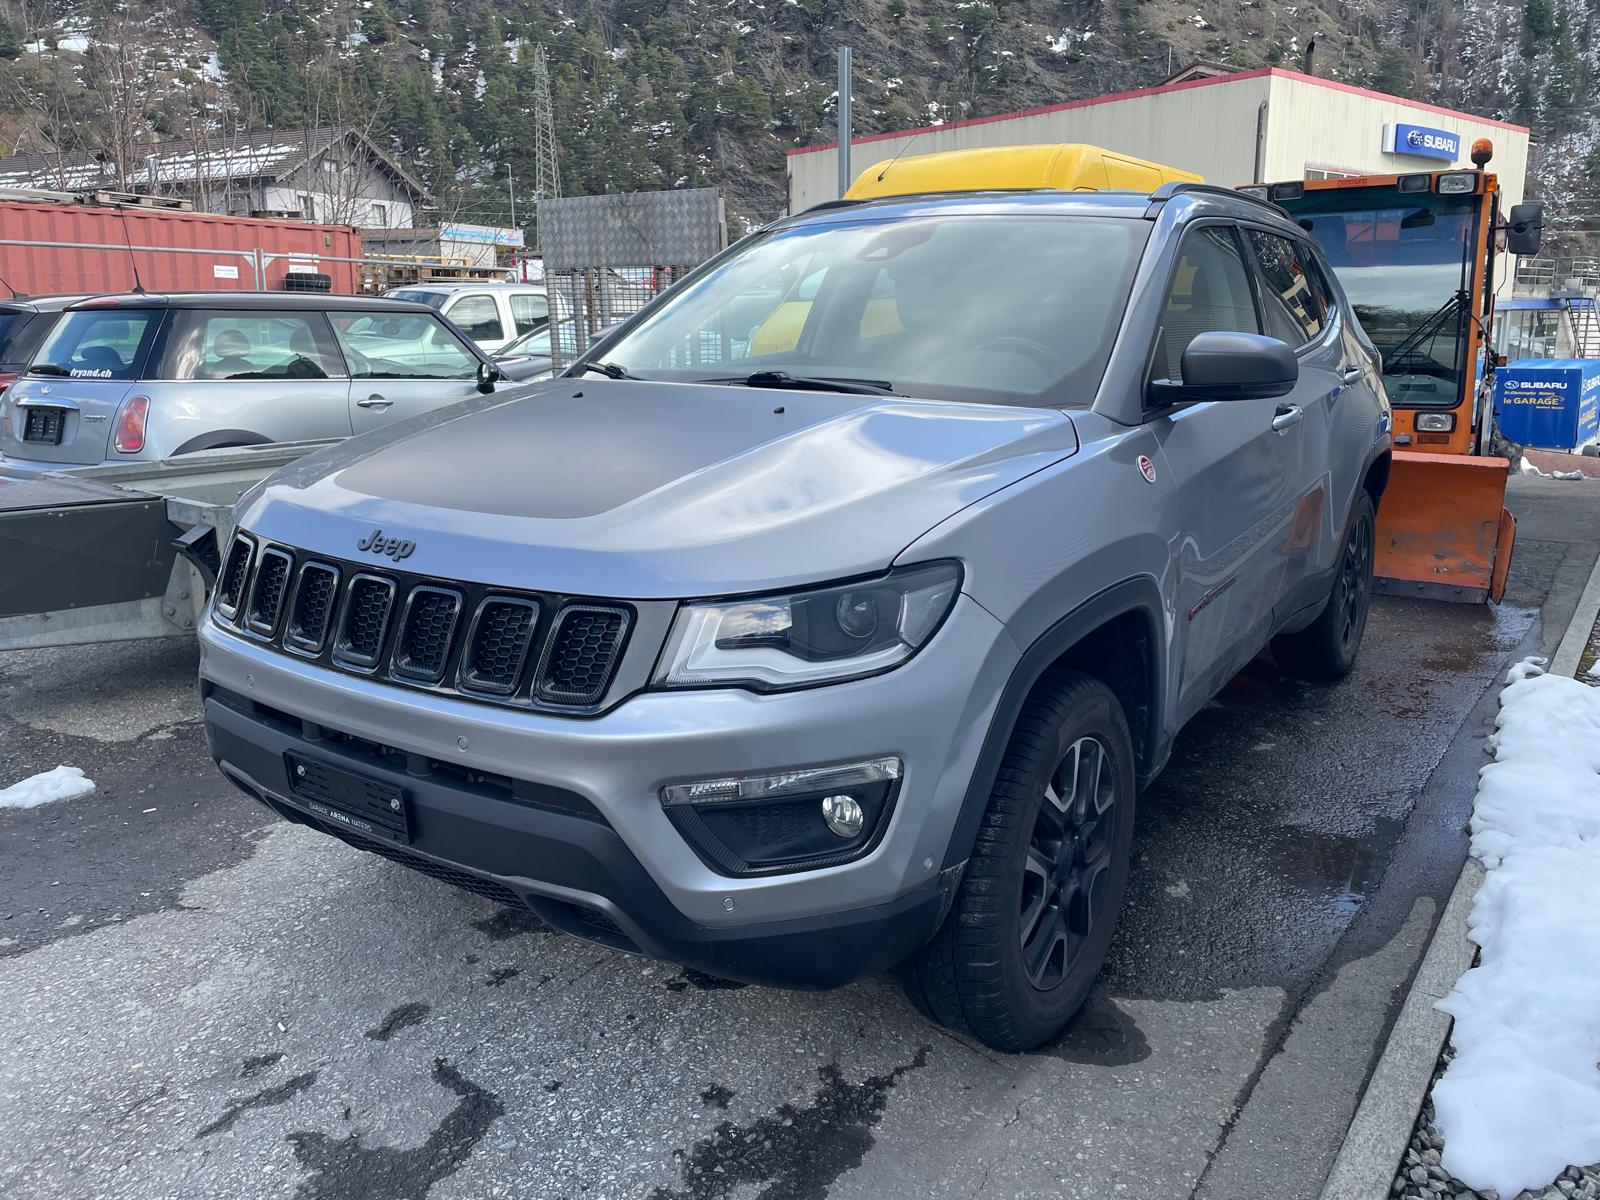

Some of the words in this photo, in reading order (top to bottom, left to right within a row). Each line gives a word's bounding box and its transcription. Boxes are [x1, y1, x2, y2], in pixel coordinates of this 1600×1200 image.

[1424, 134, 1456, 153] SUBARU
[70, 368, 112, 378] fryand.ch
[1520, 381, 1567, 389] SUBARU
[1513, 397, 1559, 405] GARAGE
[357, 529, 416, 562] Jeep
[330, 810, 350, 824] ARENA
[351, 818, 373, 832] NATERS
